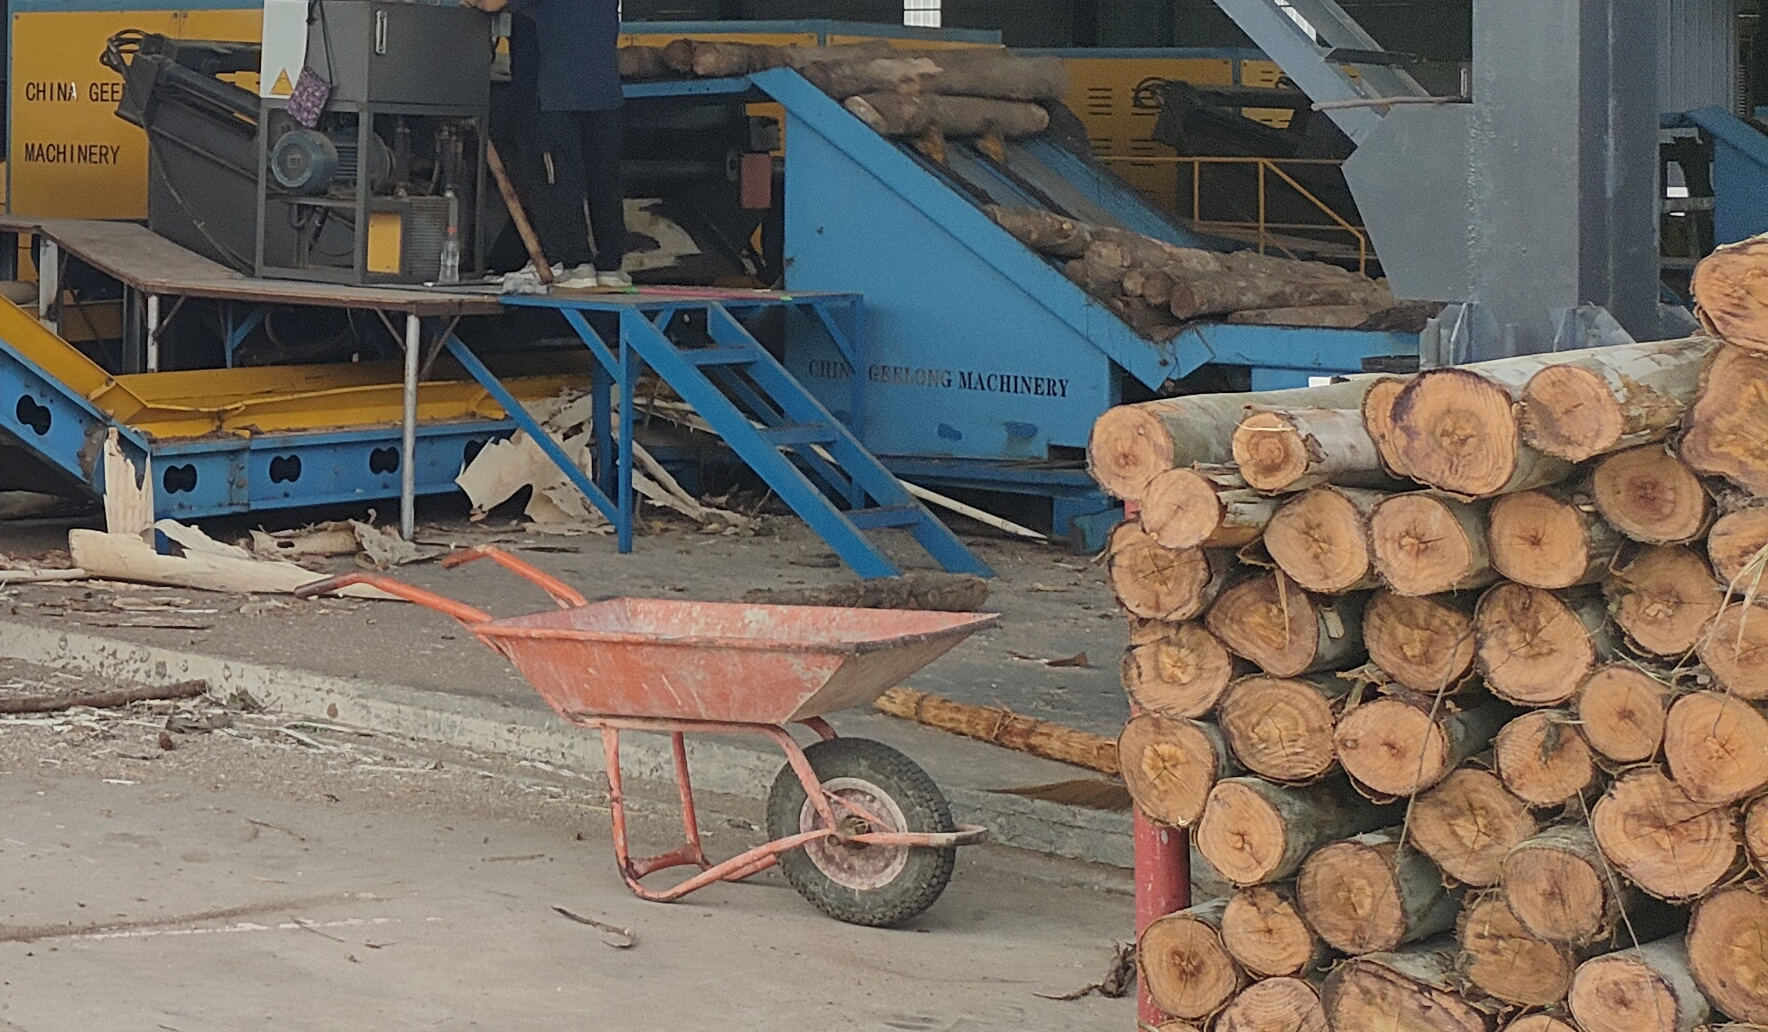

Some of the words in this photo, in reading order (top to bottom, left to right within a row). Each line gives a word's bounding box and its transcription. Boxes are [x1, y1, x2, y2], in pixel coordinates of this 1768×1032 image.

[25, 81, 77, 101] CHINA
[89, 82, 125, 102] GEE
[25, 142, 120, 165] MACHINERY
[808, 359, 852, 379] CHIN
[868, 364, 952, 388] GEELONG
[958, 370, 1069, 398] MACHINERY
